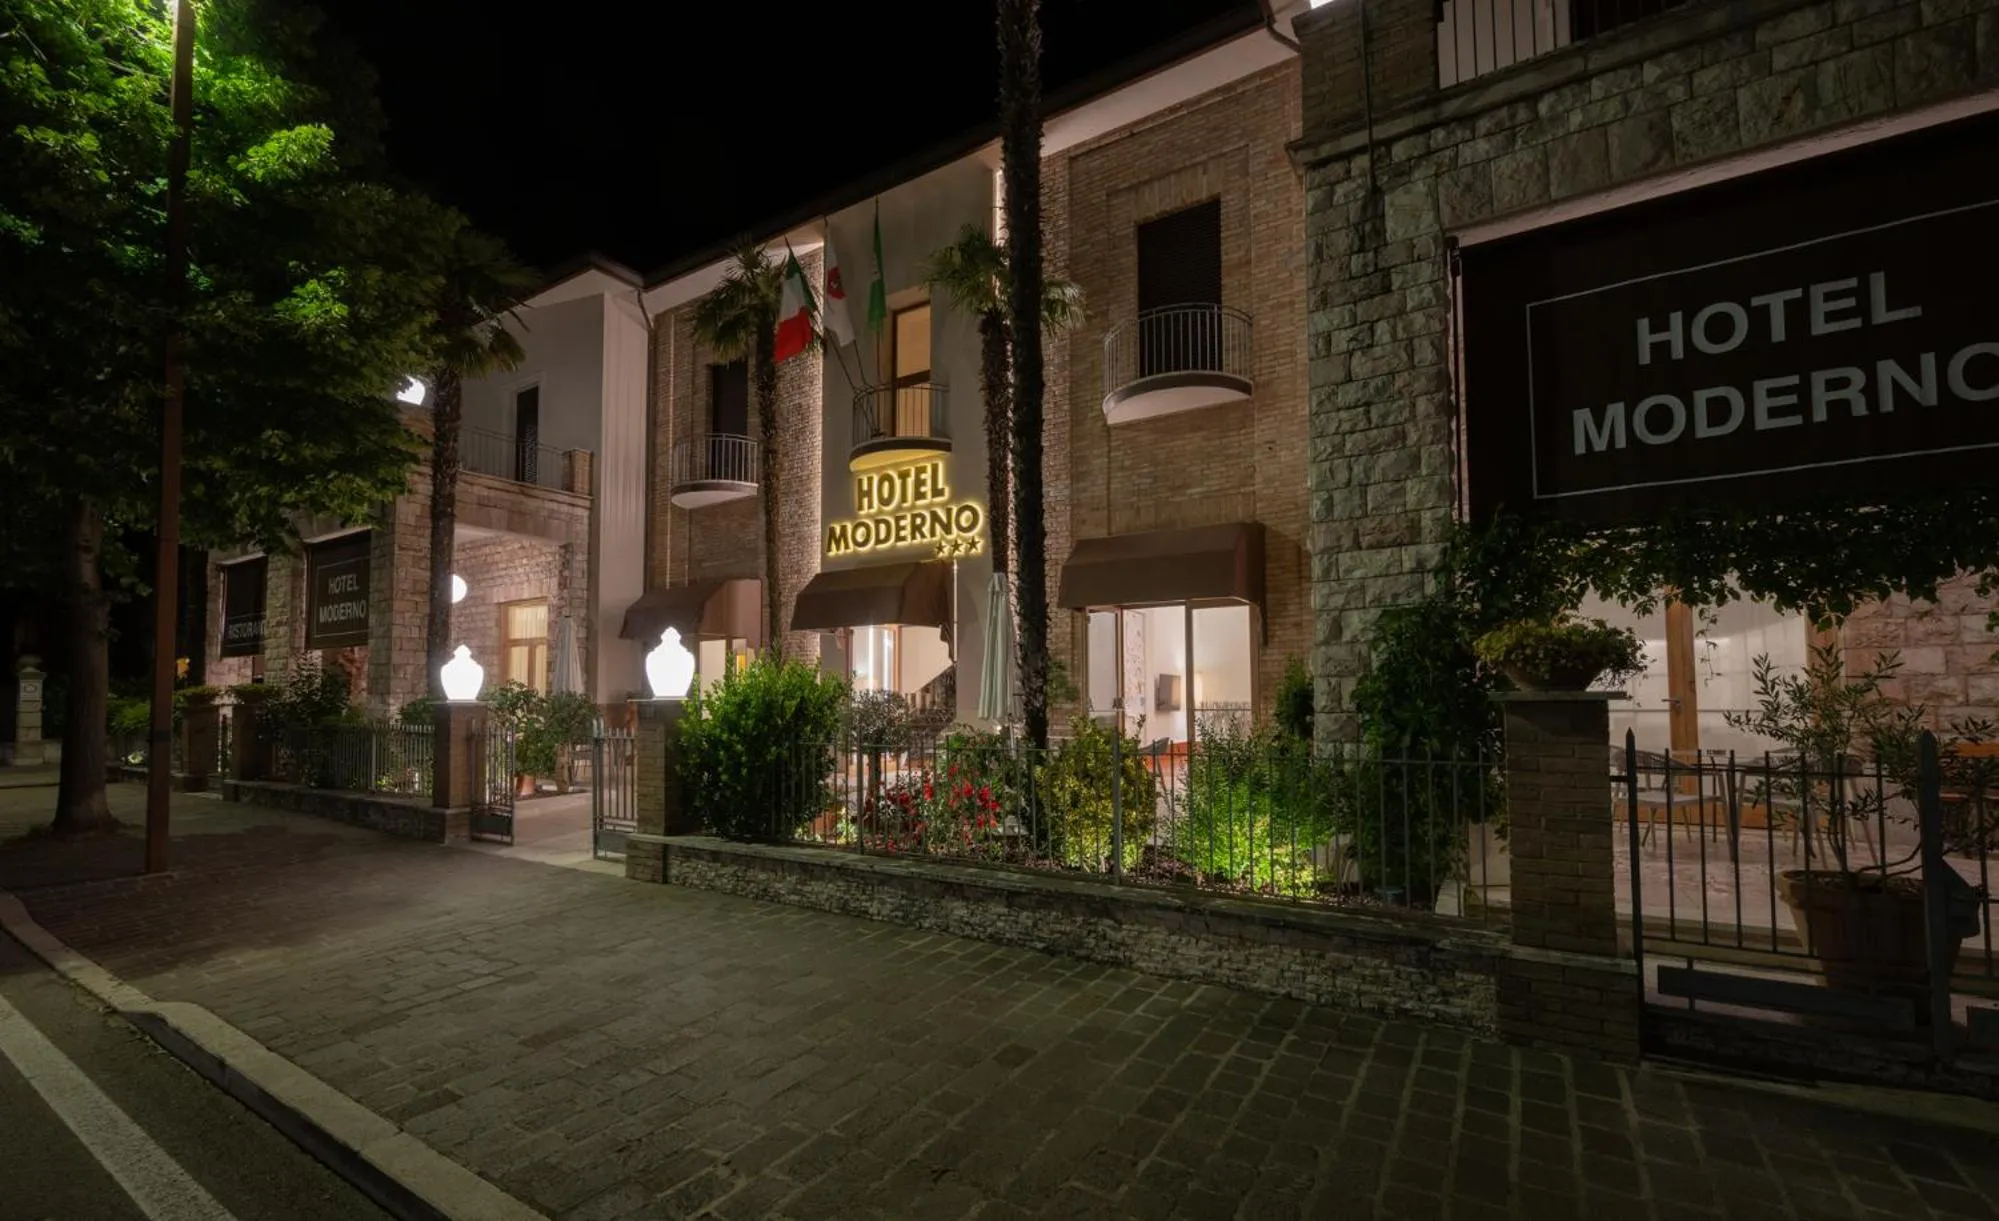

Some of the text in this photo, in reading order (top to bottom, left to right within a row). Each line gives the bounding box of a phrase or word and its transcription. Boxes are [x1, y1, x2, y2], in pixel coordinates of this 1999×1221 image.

[1636, 271, 1923, 366] HOTEL
[1572, 341, 1999, 457] MODERNO
[857, 462, 946, 513] HOTEL
[826, 503, 981, 554] MODERNO
[328, 574, 360, 595] HOTEL
[319, 599, 367, 623] MODERNO
